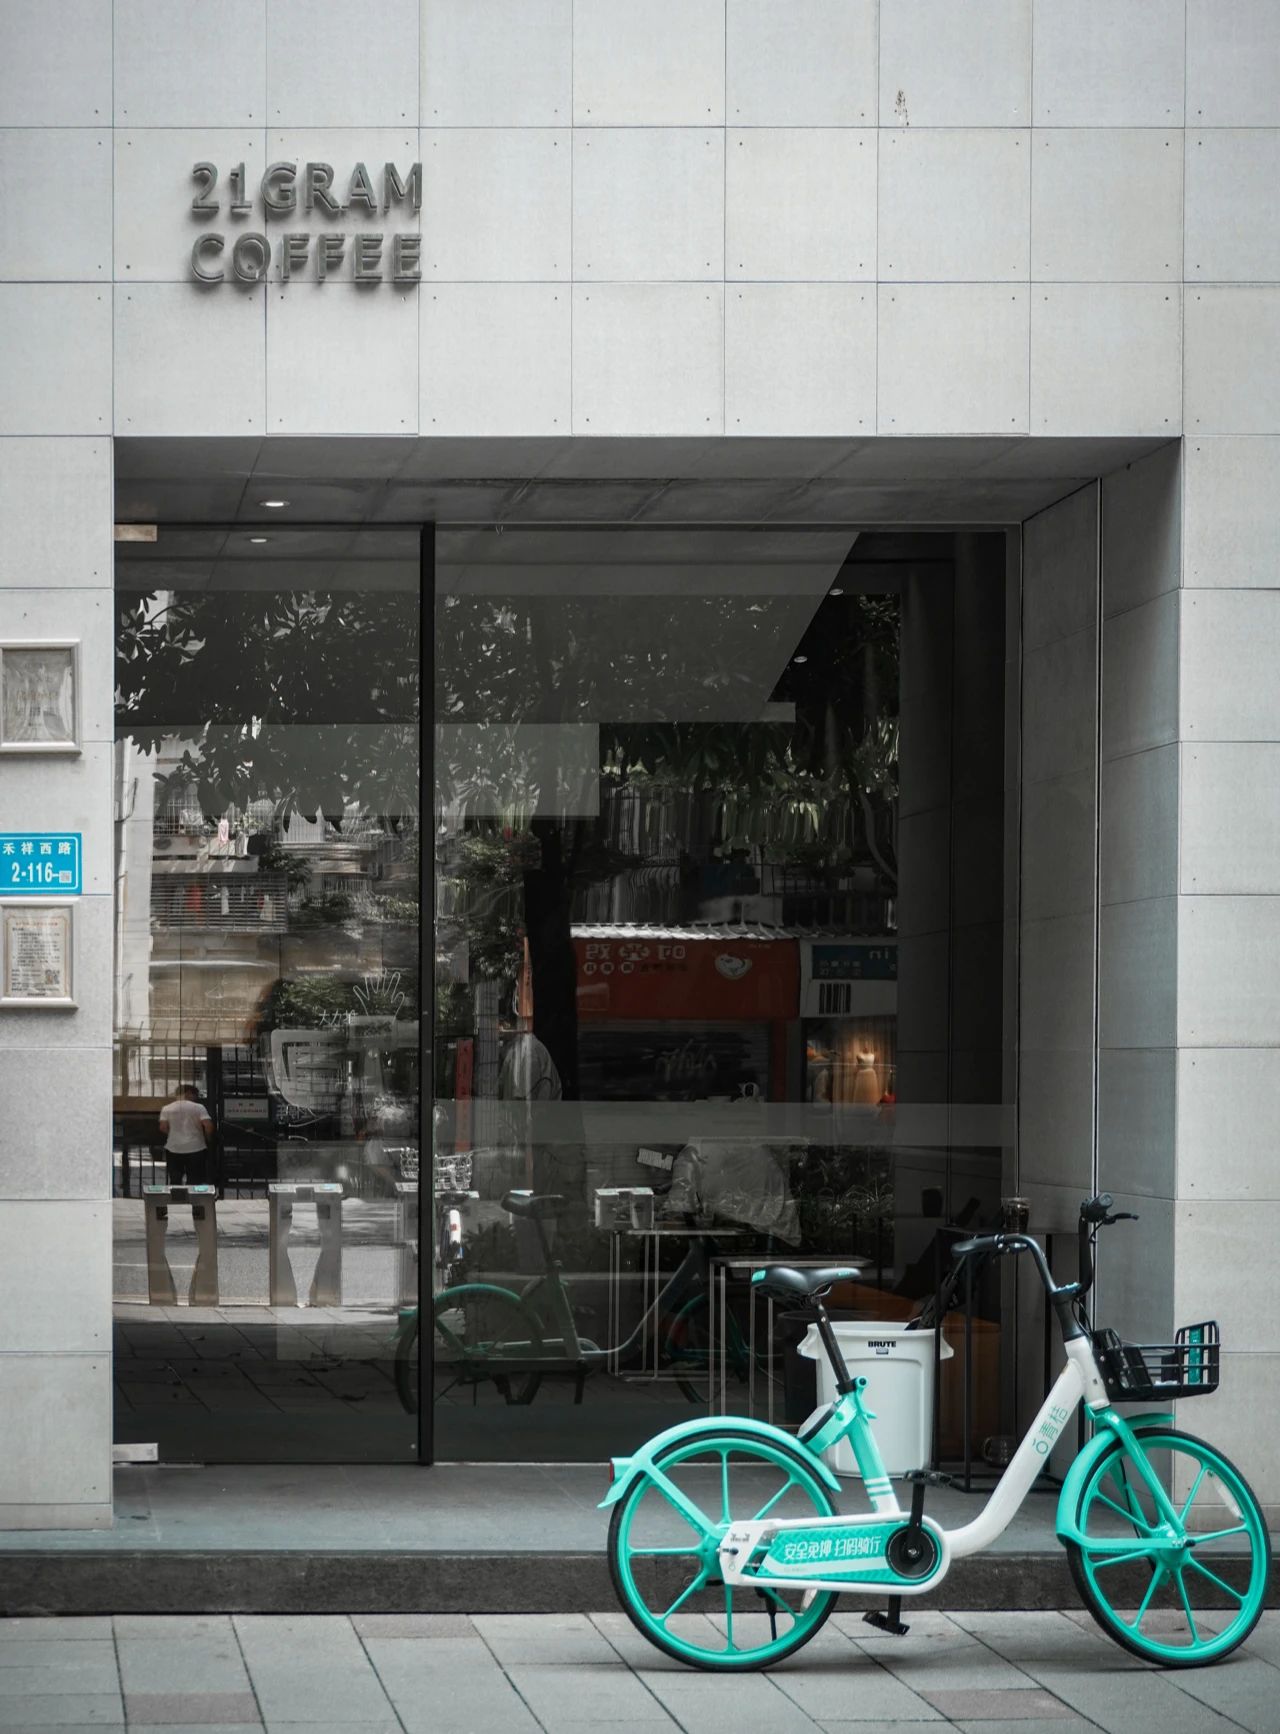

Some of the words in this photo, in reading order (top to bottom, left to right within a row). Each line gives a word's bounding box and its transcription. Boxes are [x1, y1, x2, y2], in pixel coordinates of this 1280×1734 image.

[191, 232, 423, 282] COFFEE
[2, 842, 71, 855] 禾祥西路
[868, 1340, 897, 1348] BRUTE
[1039, 1406, 1068, 1441] 青桔
[784, 1540, 832, 1561] 安全免押
[834, 1536, 882, 1557] 扫码骑行
